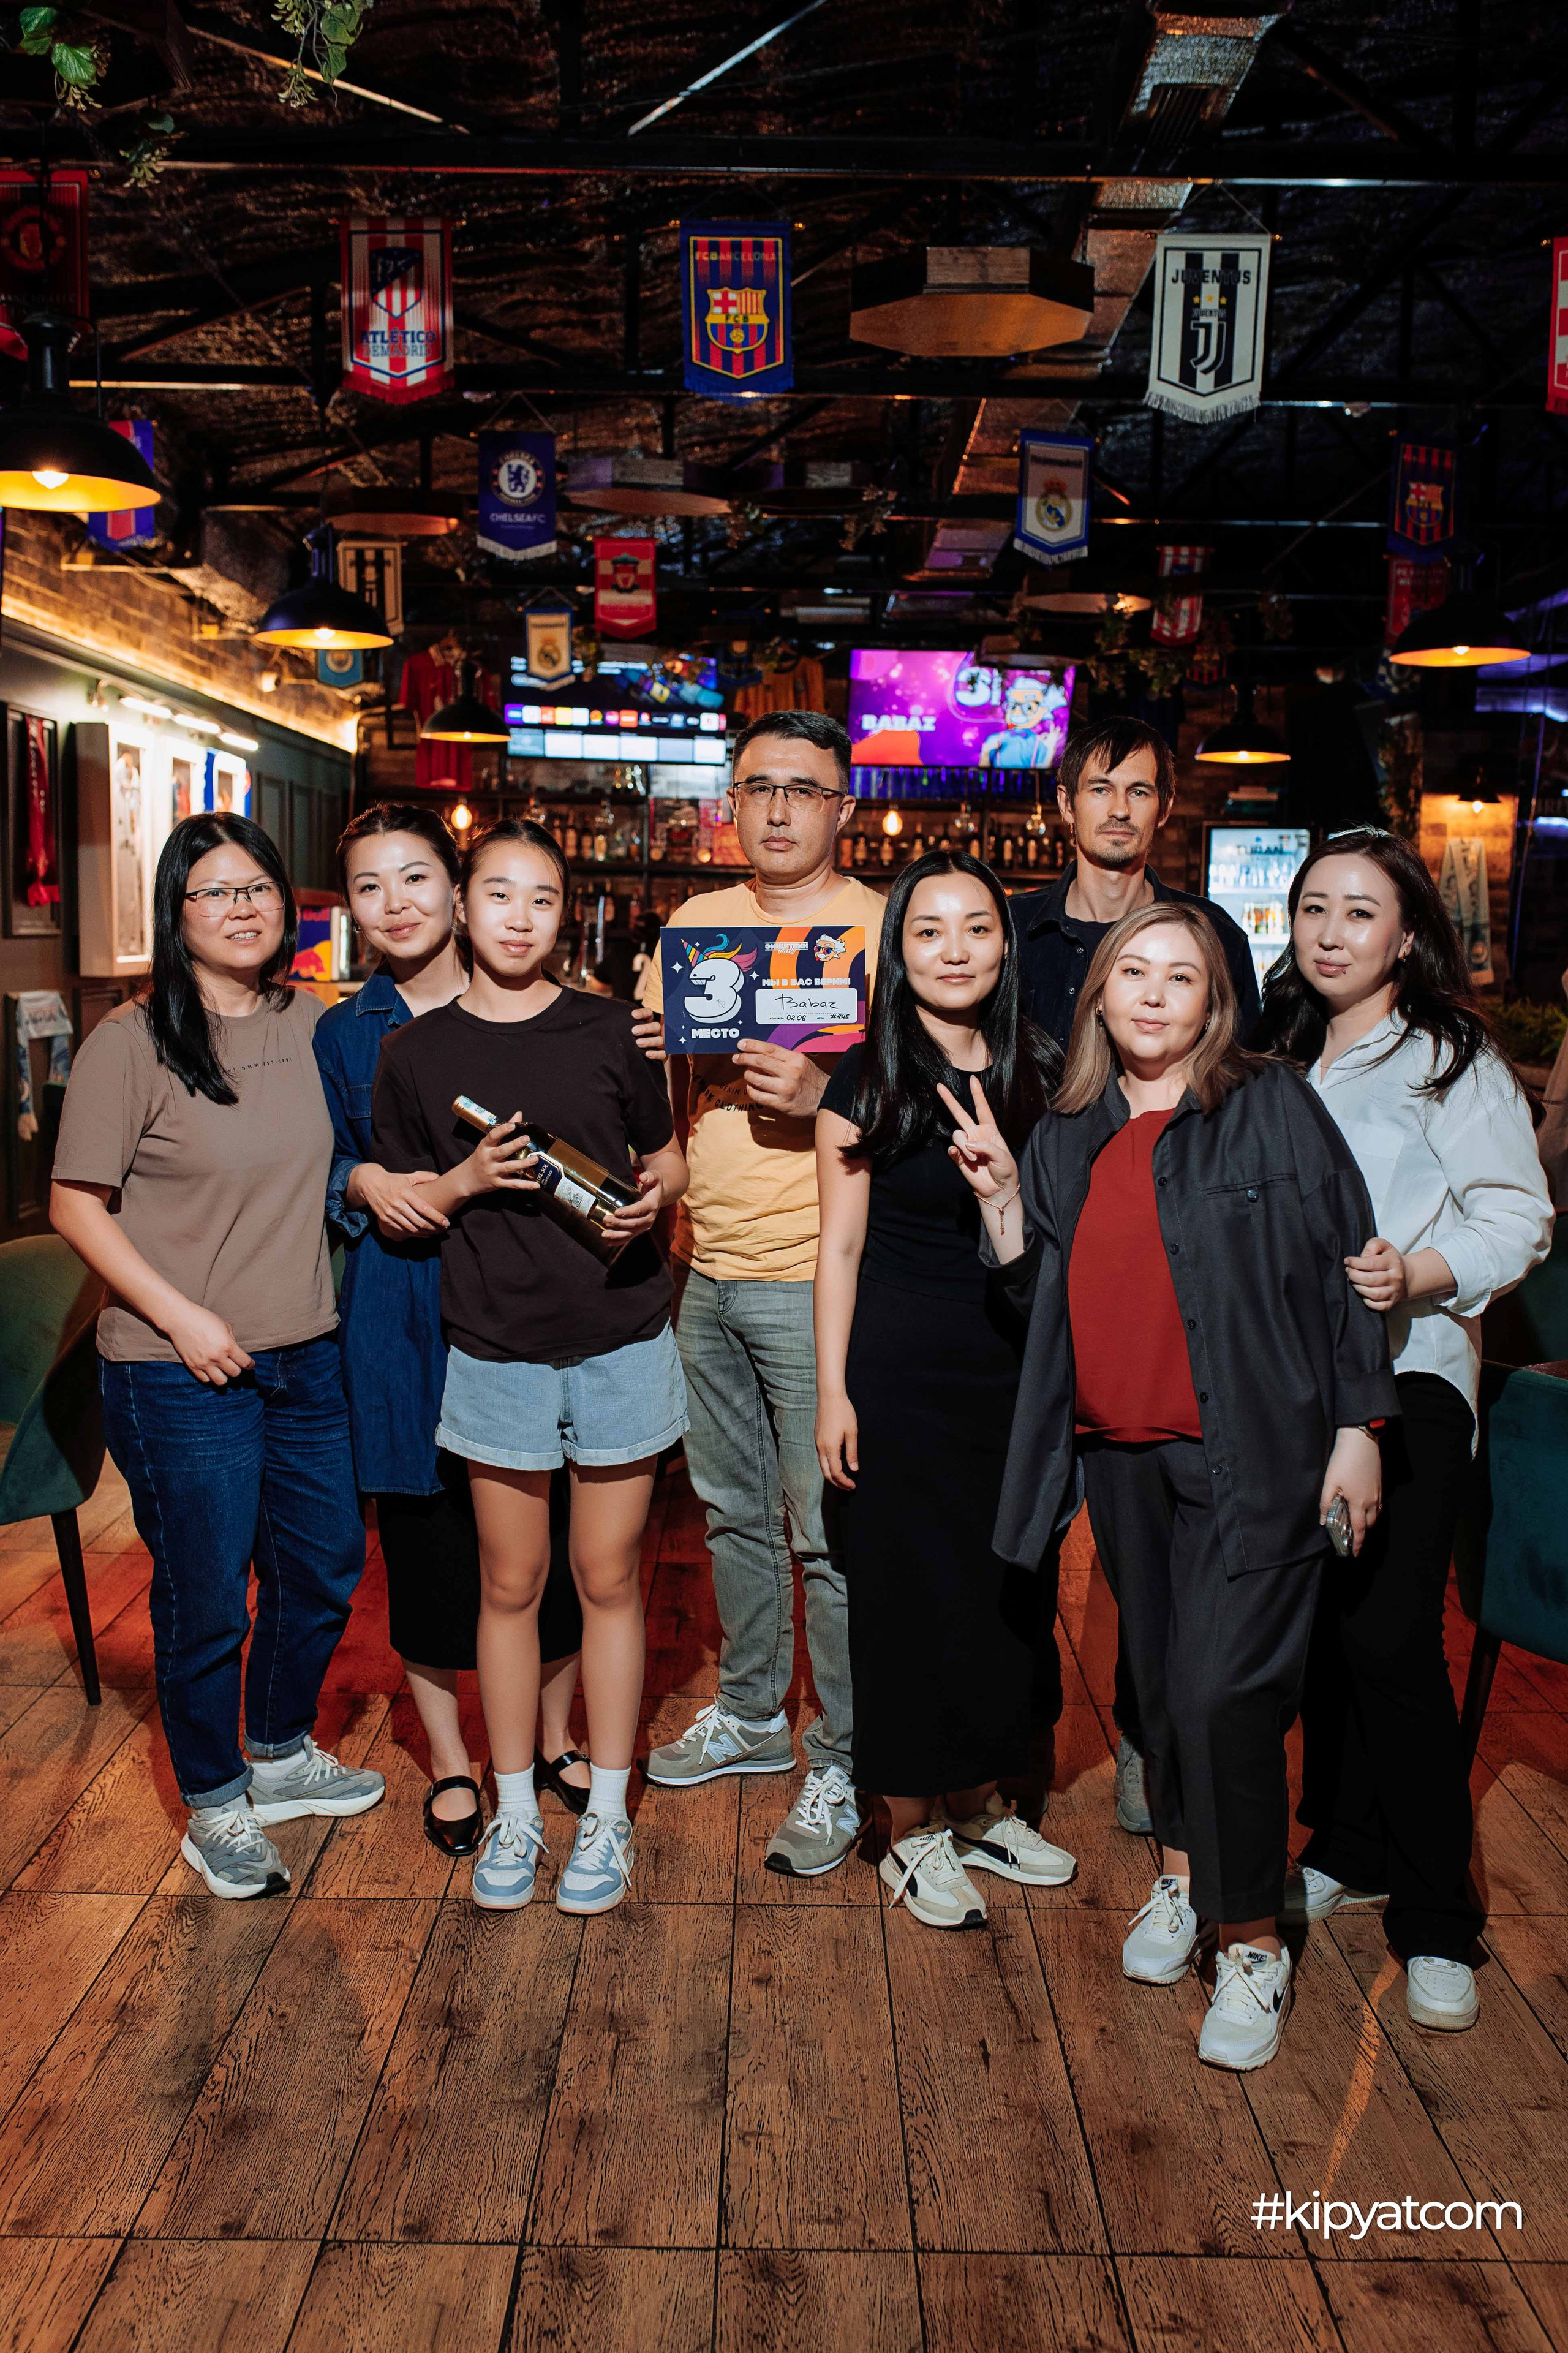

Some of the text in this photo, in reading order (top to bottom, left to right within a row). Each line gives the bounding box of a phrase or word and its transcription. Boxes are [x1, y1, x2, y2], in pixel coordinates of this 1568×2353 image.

[1172, 268, 1251, 284] JUVENTUS
[360, 328, 435, 344] ATLÉTICO
[684, 958, 744, 1024] 3
[691, 1028, 740, 1039] МЕСТО
[714, 1098, 764, 1112] CLOTHING
[1247, 1951, 1265, 1961] NIKE
